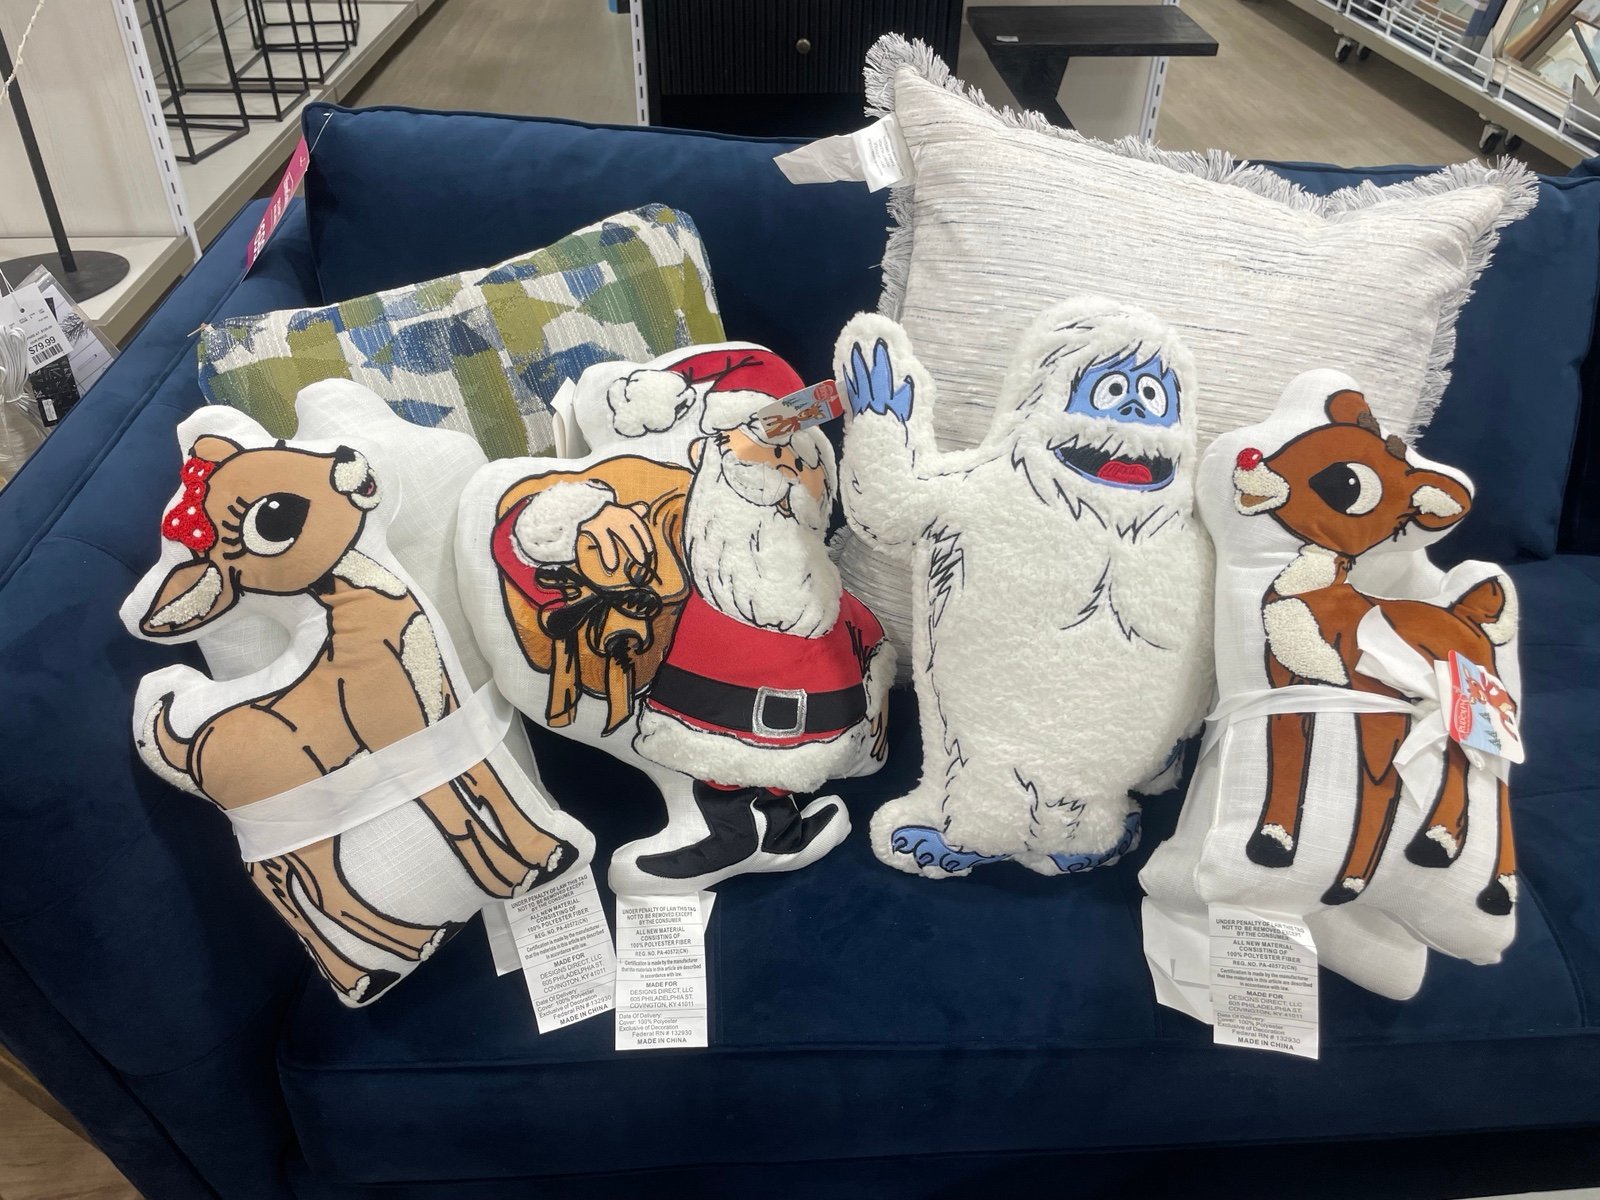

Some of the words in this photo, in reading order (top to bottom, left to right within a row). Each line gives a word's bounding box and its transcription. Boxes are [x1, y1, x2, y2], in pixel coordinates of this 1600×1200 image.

[28, 336, 56, 355] $79.99
[543, 889, 567, 902] REMOVED
[566, 881, 585, 892] EXCEPT
[548, 891, 574, 905] CONSUMER
[511, 898, 528, 909] UNDER
[528, 890, 549, 902] PENALTY
[553, 898, 580, 912] MATERIAL
[527, 924, 542, 933] 100%
[541, 913, 573, 928] POLYESTER
[572, 907, 589, 917] FIBER
[536, 908, 569, 924] CONSISTING
[1261, 942, 1294, 950] MATERIAL
[553, 957, 572, 967] MADE
[539, 966, 567, 980] DESIGNS
[553, 963, 595, 983] PHILADELPHIA
[535, 998, 549, 1007] Date
[556, 997, 571, 1006] 100%
[570, 988, 595, 1001] Polyester
[1228, 995, 1259, 1003] DESIGNS
[539, 1006, 564, 1018] Exclusive
[570, 993, 598, 1007] Decoration
[1241, 1002, 1291, 1012] PHILADELPHIA
[553, 1007, 575, 1020] Federal
[560, 1014, 579, 1025] MADE
[587, 1004, 608, 1015] CHINA
[1232, 1029, 1257, 1037] Federal
[1238, 1037, 1260, 1045] MADE
[1270, 1042, 1294, 1050] CHINA
